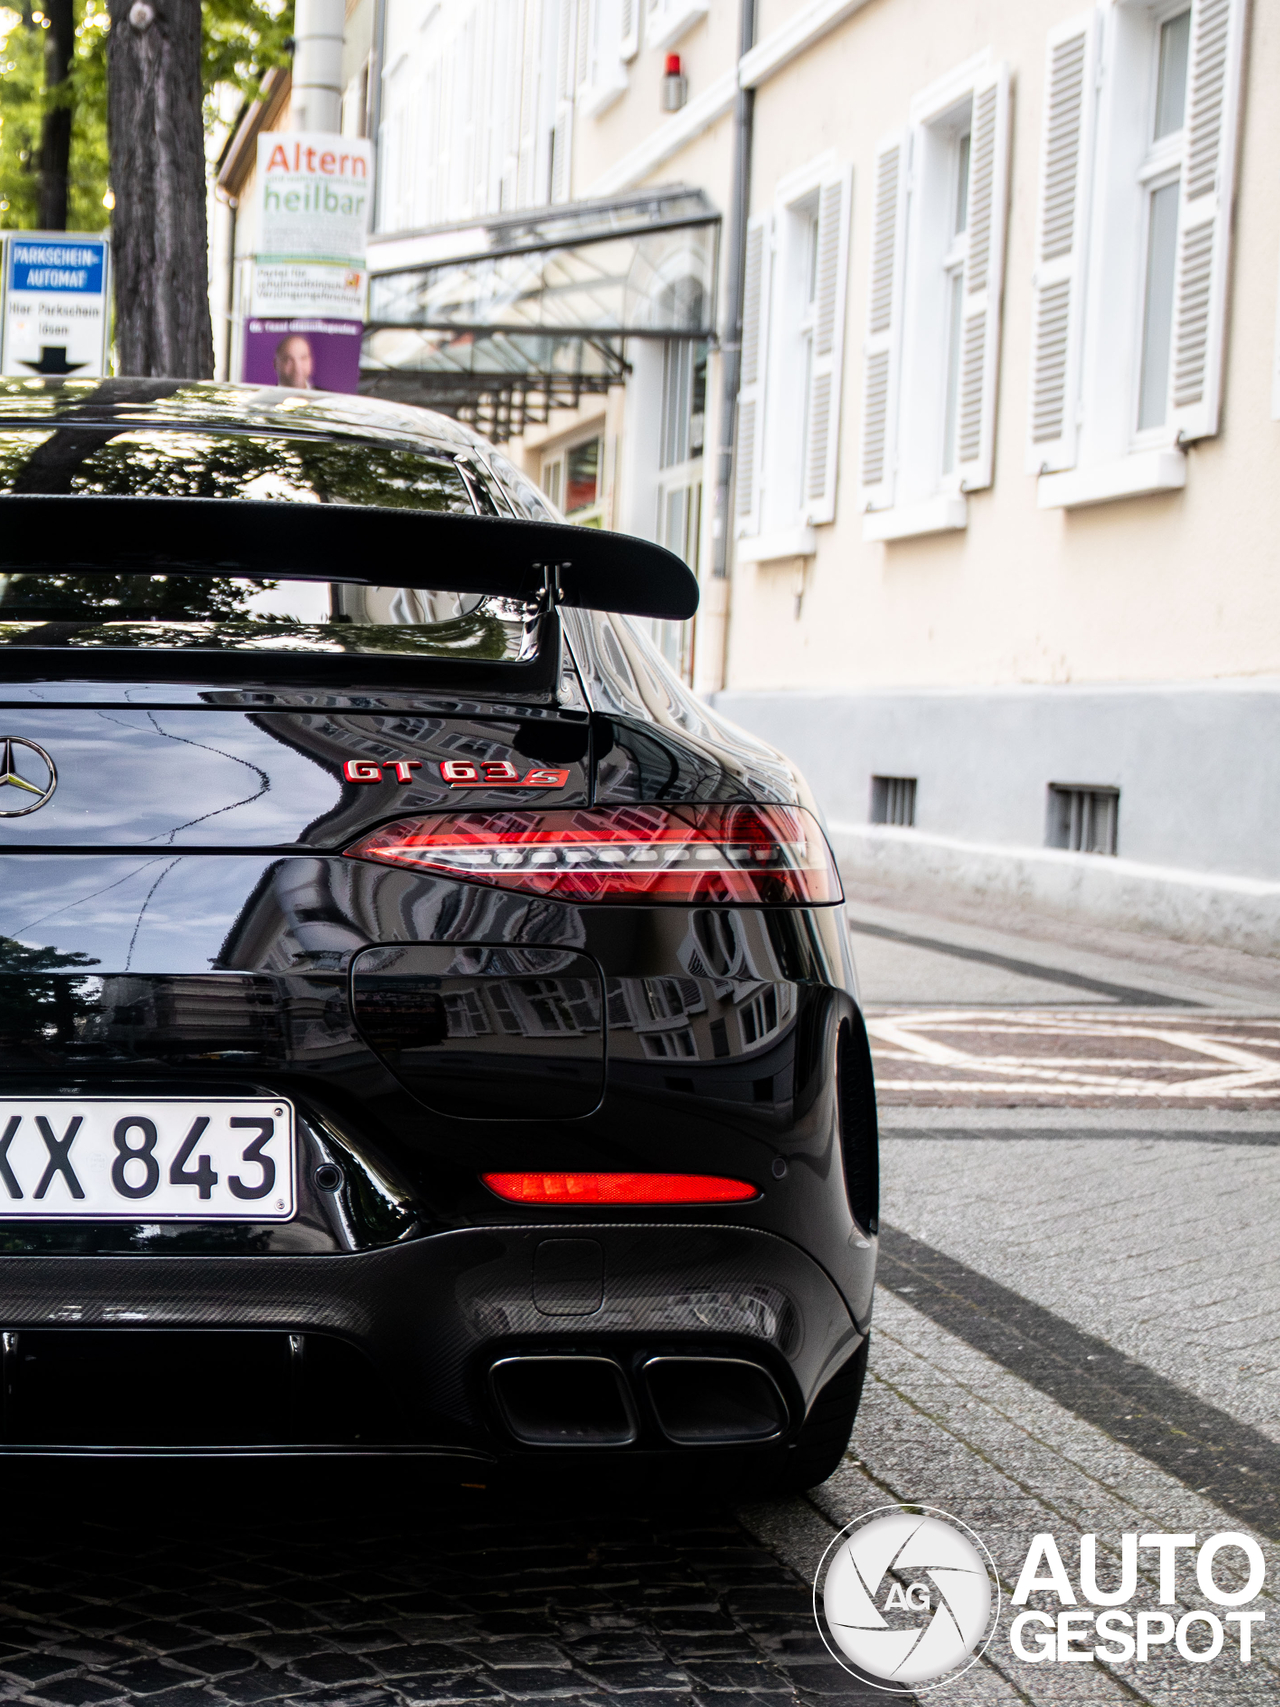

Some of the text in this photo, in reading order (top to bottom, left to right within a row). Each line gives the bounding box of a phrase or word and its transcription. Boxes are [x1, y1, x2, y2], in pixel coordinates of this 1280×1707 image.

[266, 141, 366, 178] Altern
[264, 183, 365, 215] heilbar
[26, 267, 88, 288] AUTOMAT
[10, 302, 100, 318] Hier Parkschein
[40, 322, 69, 336] lösen
[343, 760, 423, 783] GT
[439, 760, 520, 783] 63
[111, 1115, 276, 1200] 843
